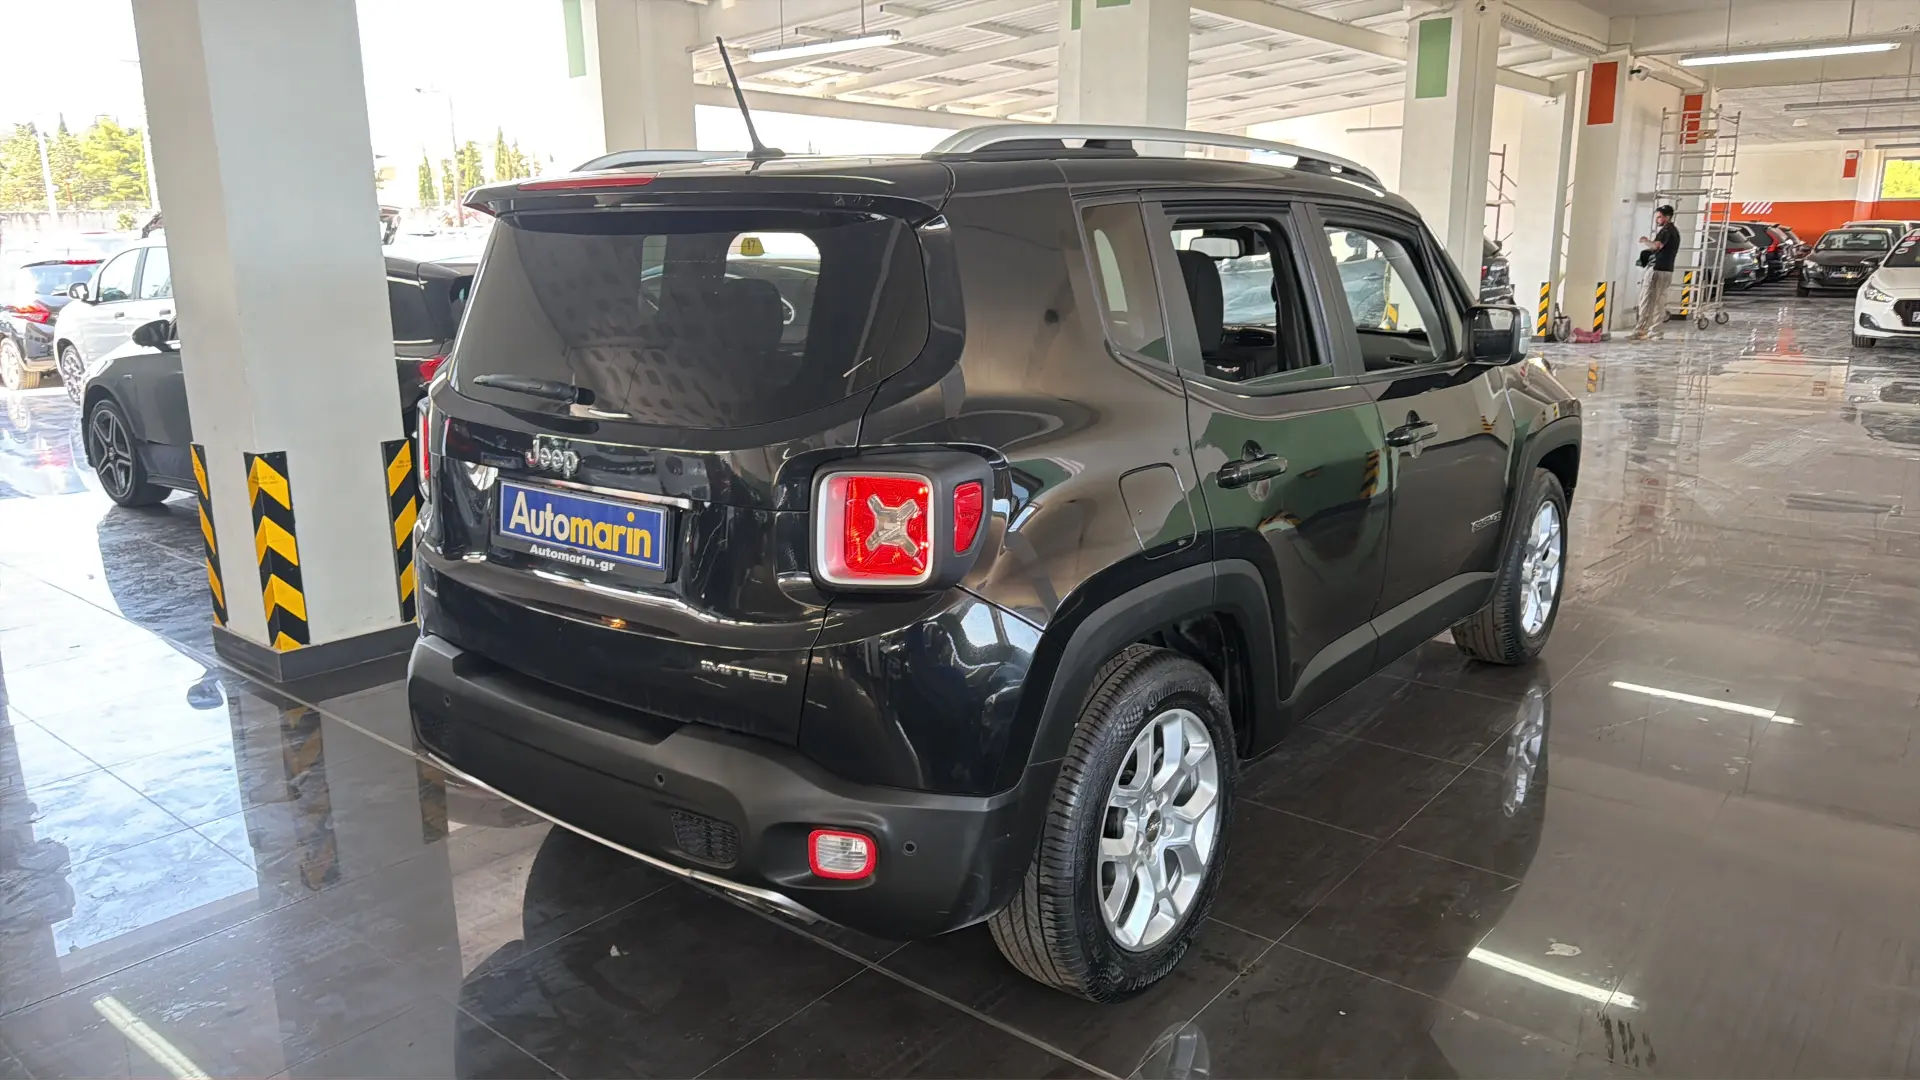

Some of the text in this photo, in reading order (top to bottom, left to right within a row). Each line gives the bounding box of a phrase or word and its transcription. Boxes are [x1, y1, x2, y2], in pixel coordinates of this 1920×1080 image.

[525, 439, 579, 479] Jeep
[508, 490, 651, 558] Automarin
[529, 544, 616, 572] Automarin.gr
